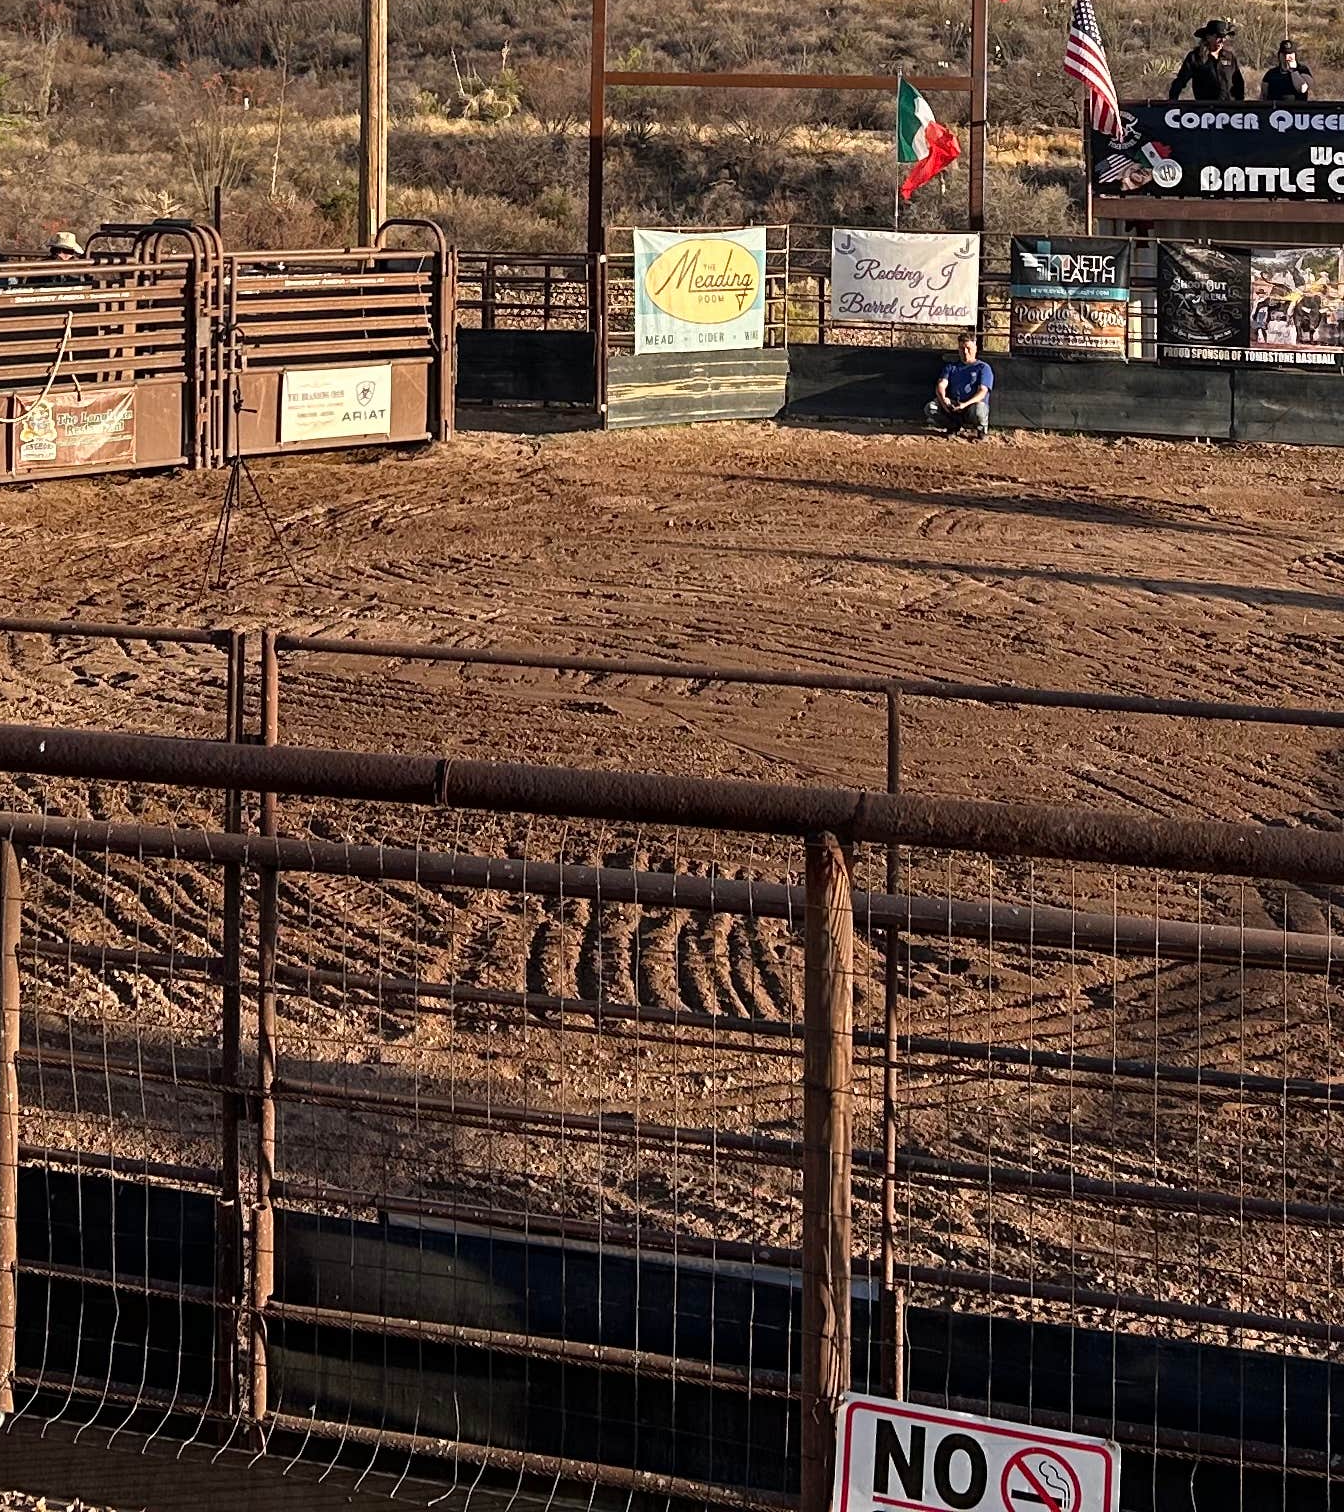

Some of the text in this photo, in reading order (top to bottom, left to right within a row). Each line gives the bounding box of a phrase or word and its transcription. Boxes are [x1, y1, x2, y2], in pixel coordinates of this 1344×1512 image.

[1164, 108, 1260, 131] COPPER
[1200, 165, 1316, 193] BATTLE
[655, 249, 754, 296] Meading
[854, 259, 924, 288] Rocking
[1048, 269, 1115, 283] HEALTH
[839, 292, 899, 314] Barrel
[645, 335, 674, 345] MEAD
[699, 332, 725, 343] CIDER
[1163, 347, 1336, 365] PROUD SPONSOR OF TOMBSTONE BASEBALL
[342, 409, 387, 422] ARIAT
[873, 1418, 988, 1510] NO
